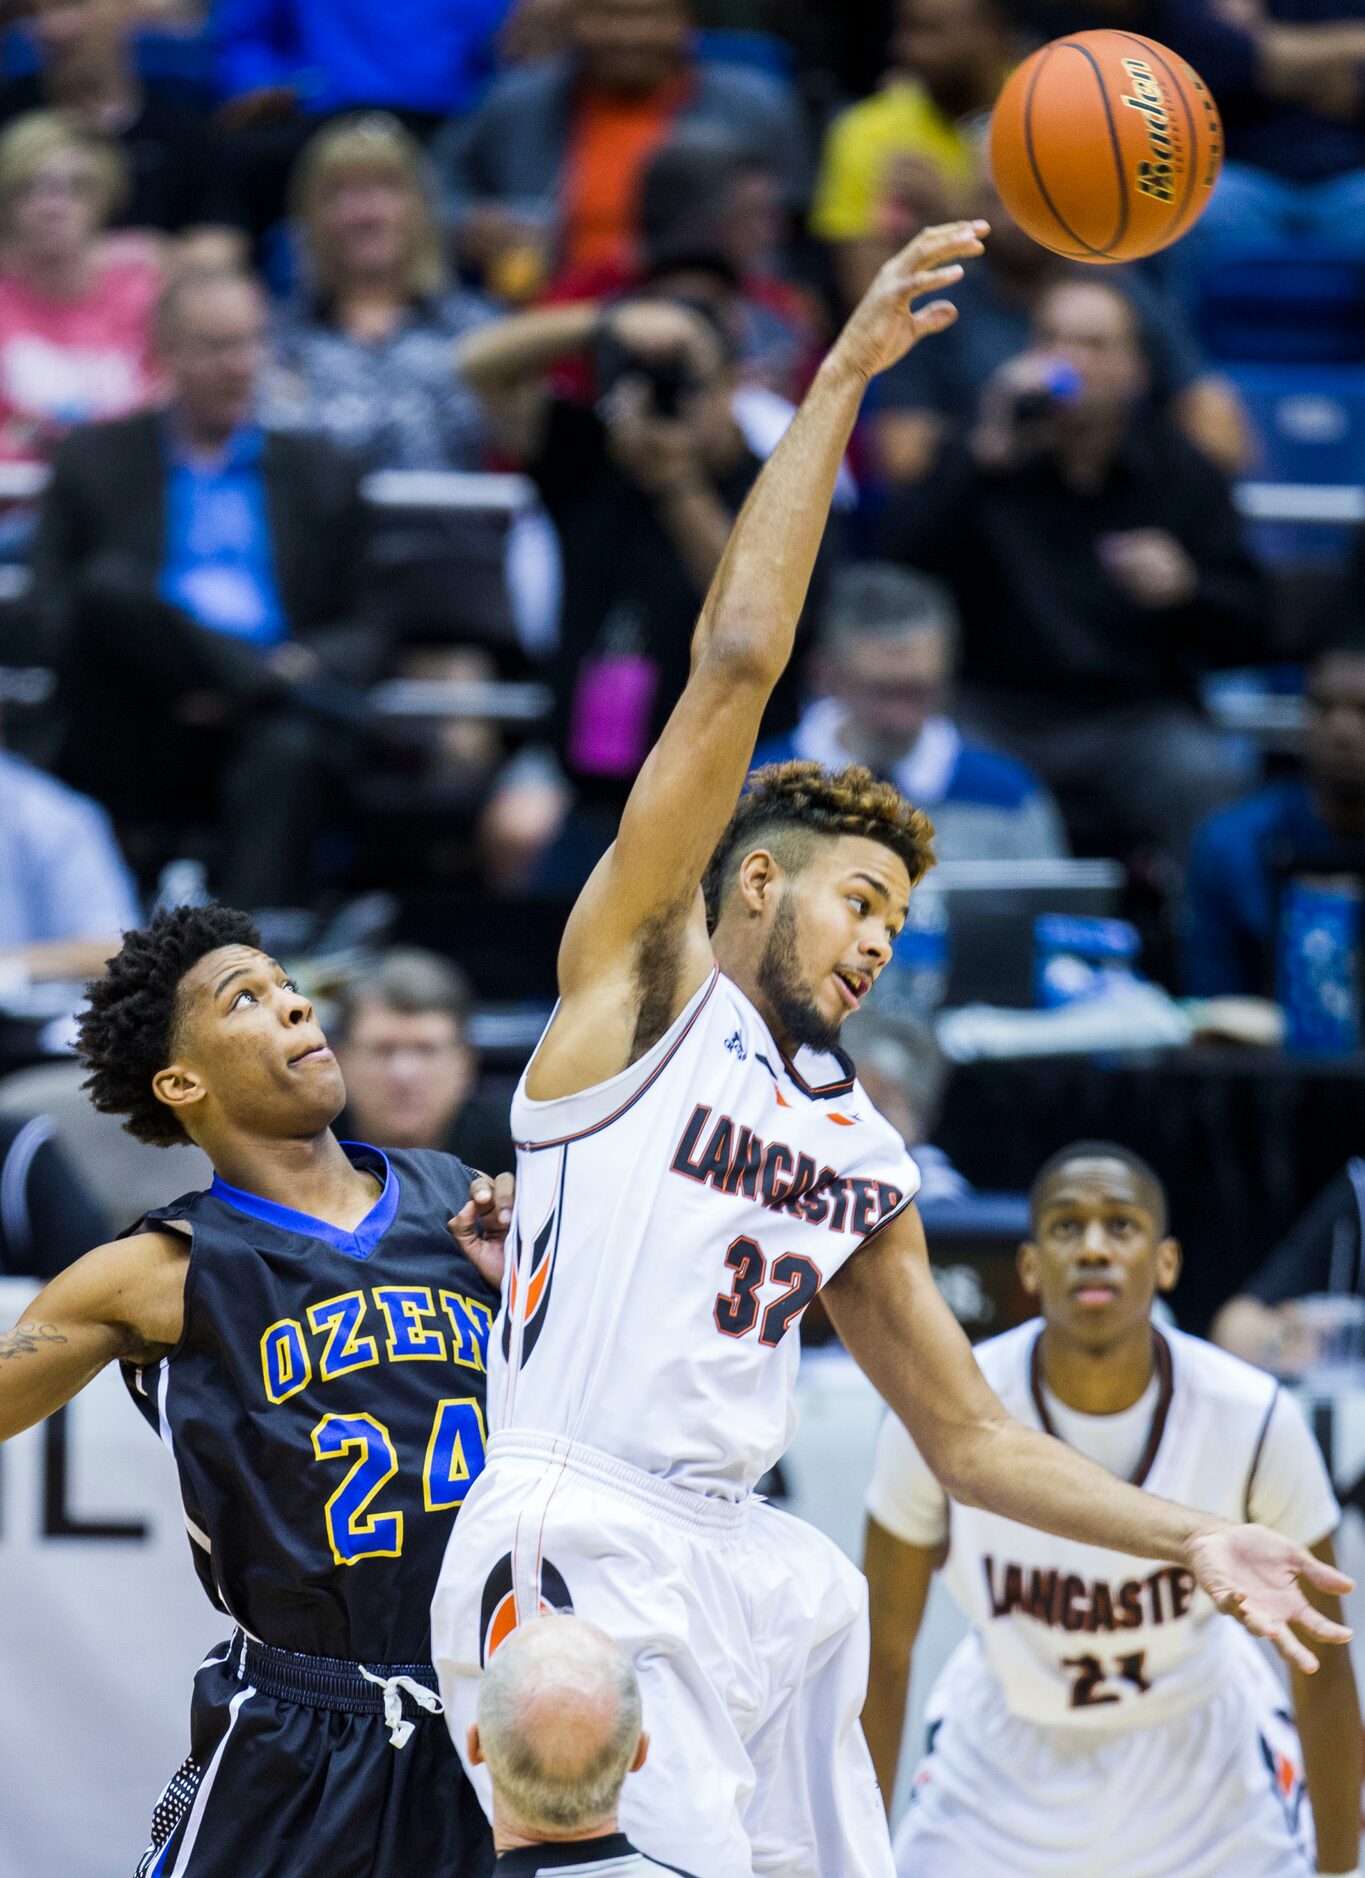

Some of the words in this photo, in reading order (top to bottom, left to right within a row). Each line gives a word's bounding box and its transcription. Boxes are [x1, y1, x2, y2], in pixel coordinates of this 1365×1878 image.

[1121, 57, 1176, 205] Baden
[260, 1286, 493, 1405] OZEN
[713, 1235, 822, 1348] 32
[310, 1397, 488, 1566] 24
